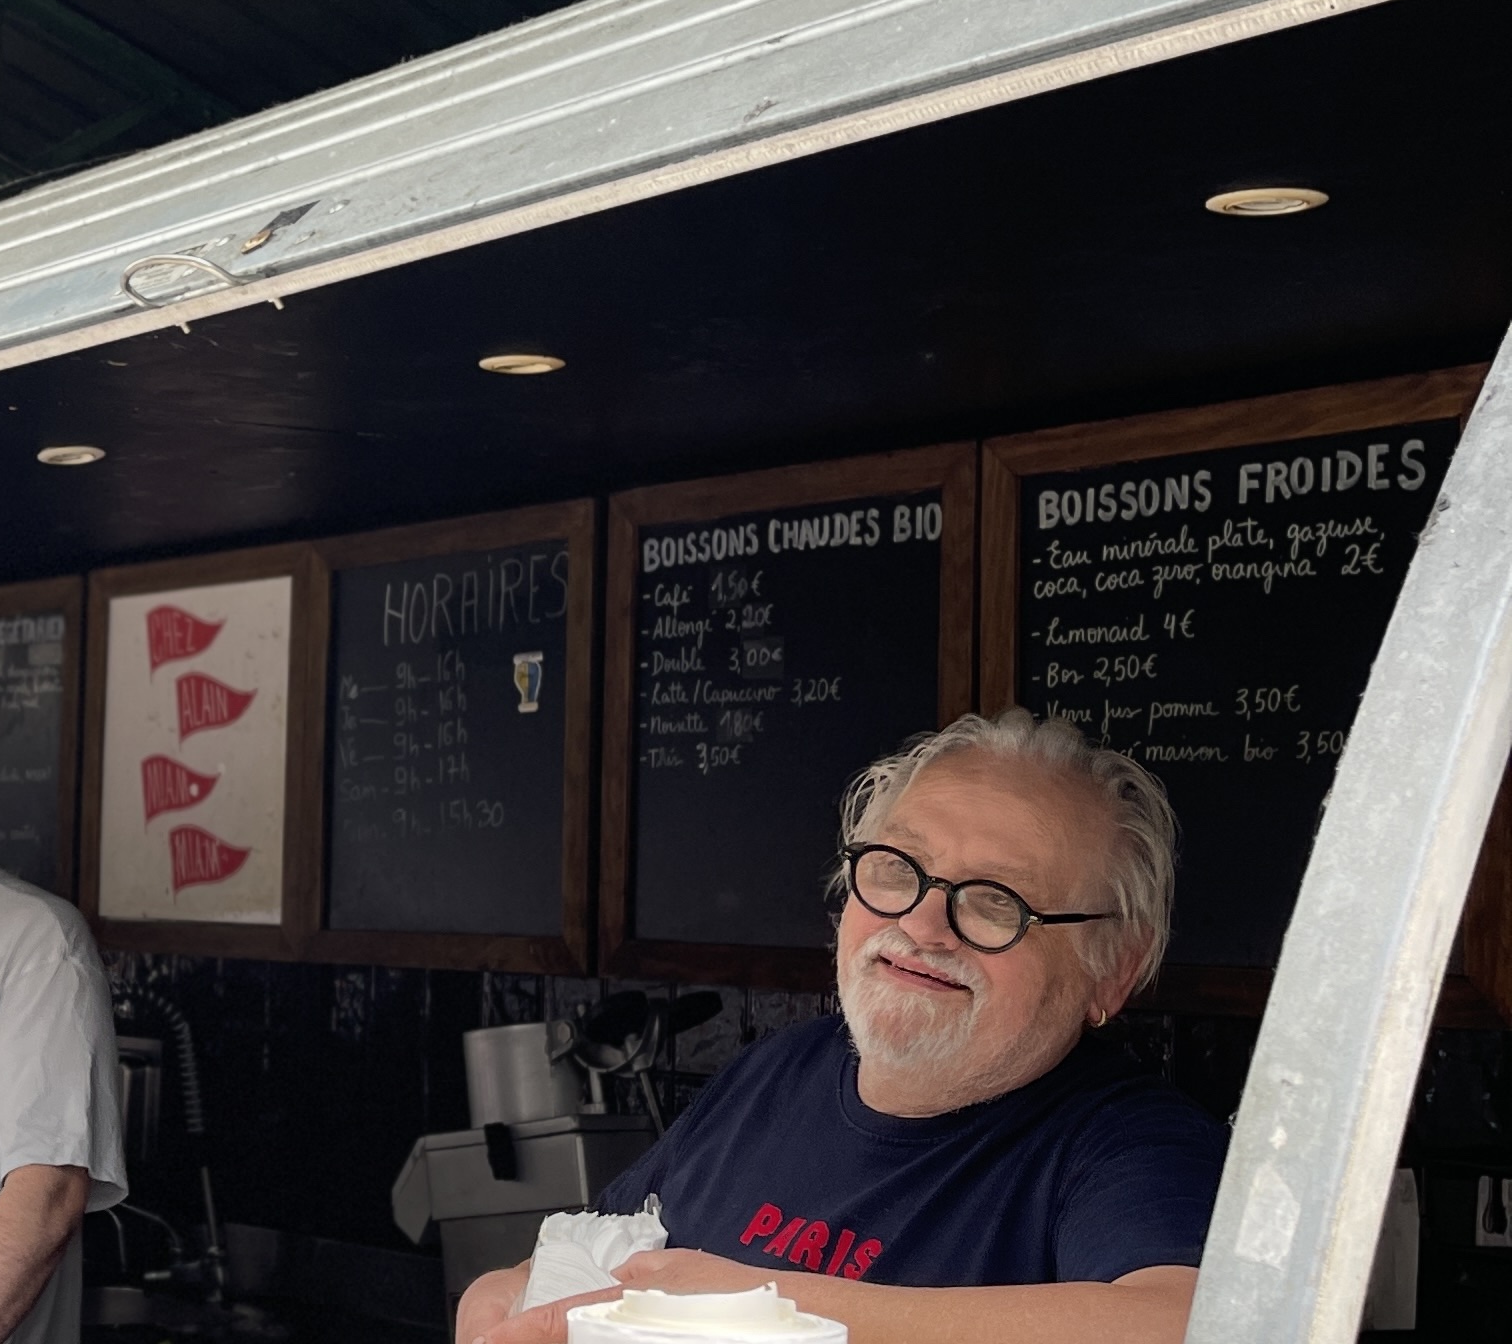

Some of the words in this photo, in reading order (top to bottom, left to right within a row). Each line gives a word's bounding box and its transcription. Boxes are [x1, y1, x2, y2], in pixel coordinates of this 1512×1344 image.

[1037, 468, 1213, 530] BOISSONS
[1237, 438, 1428, 506] FROIDES
[642, 522, 760, 573] BOISSONS
[767, 507, 881, 554] CHAUDES
[892, 502, 944, 543] BIO
[1048, 539, 1092, 570] Eau
[1101, 523, 1199, 561] minérale
[1094, 567, 1145, 592] coca
[1340, 543, 1384, 576] 2€
[150, 610, 197, 663] CHEZ
[1162, 609, 1196, 640] 4€
[181, 677, 229, 729] ALAIN
[1234, 684, 1302, 721] 3,50€
[1242, 733, 1279, 762] bio
[146, 761, 190, 813] MIAM
[739, 1202, 884, 1281] PARIS
